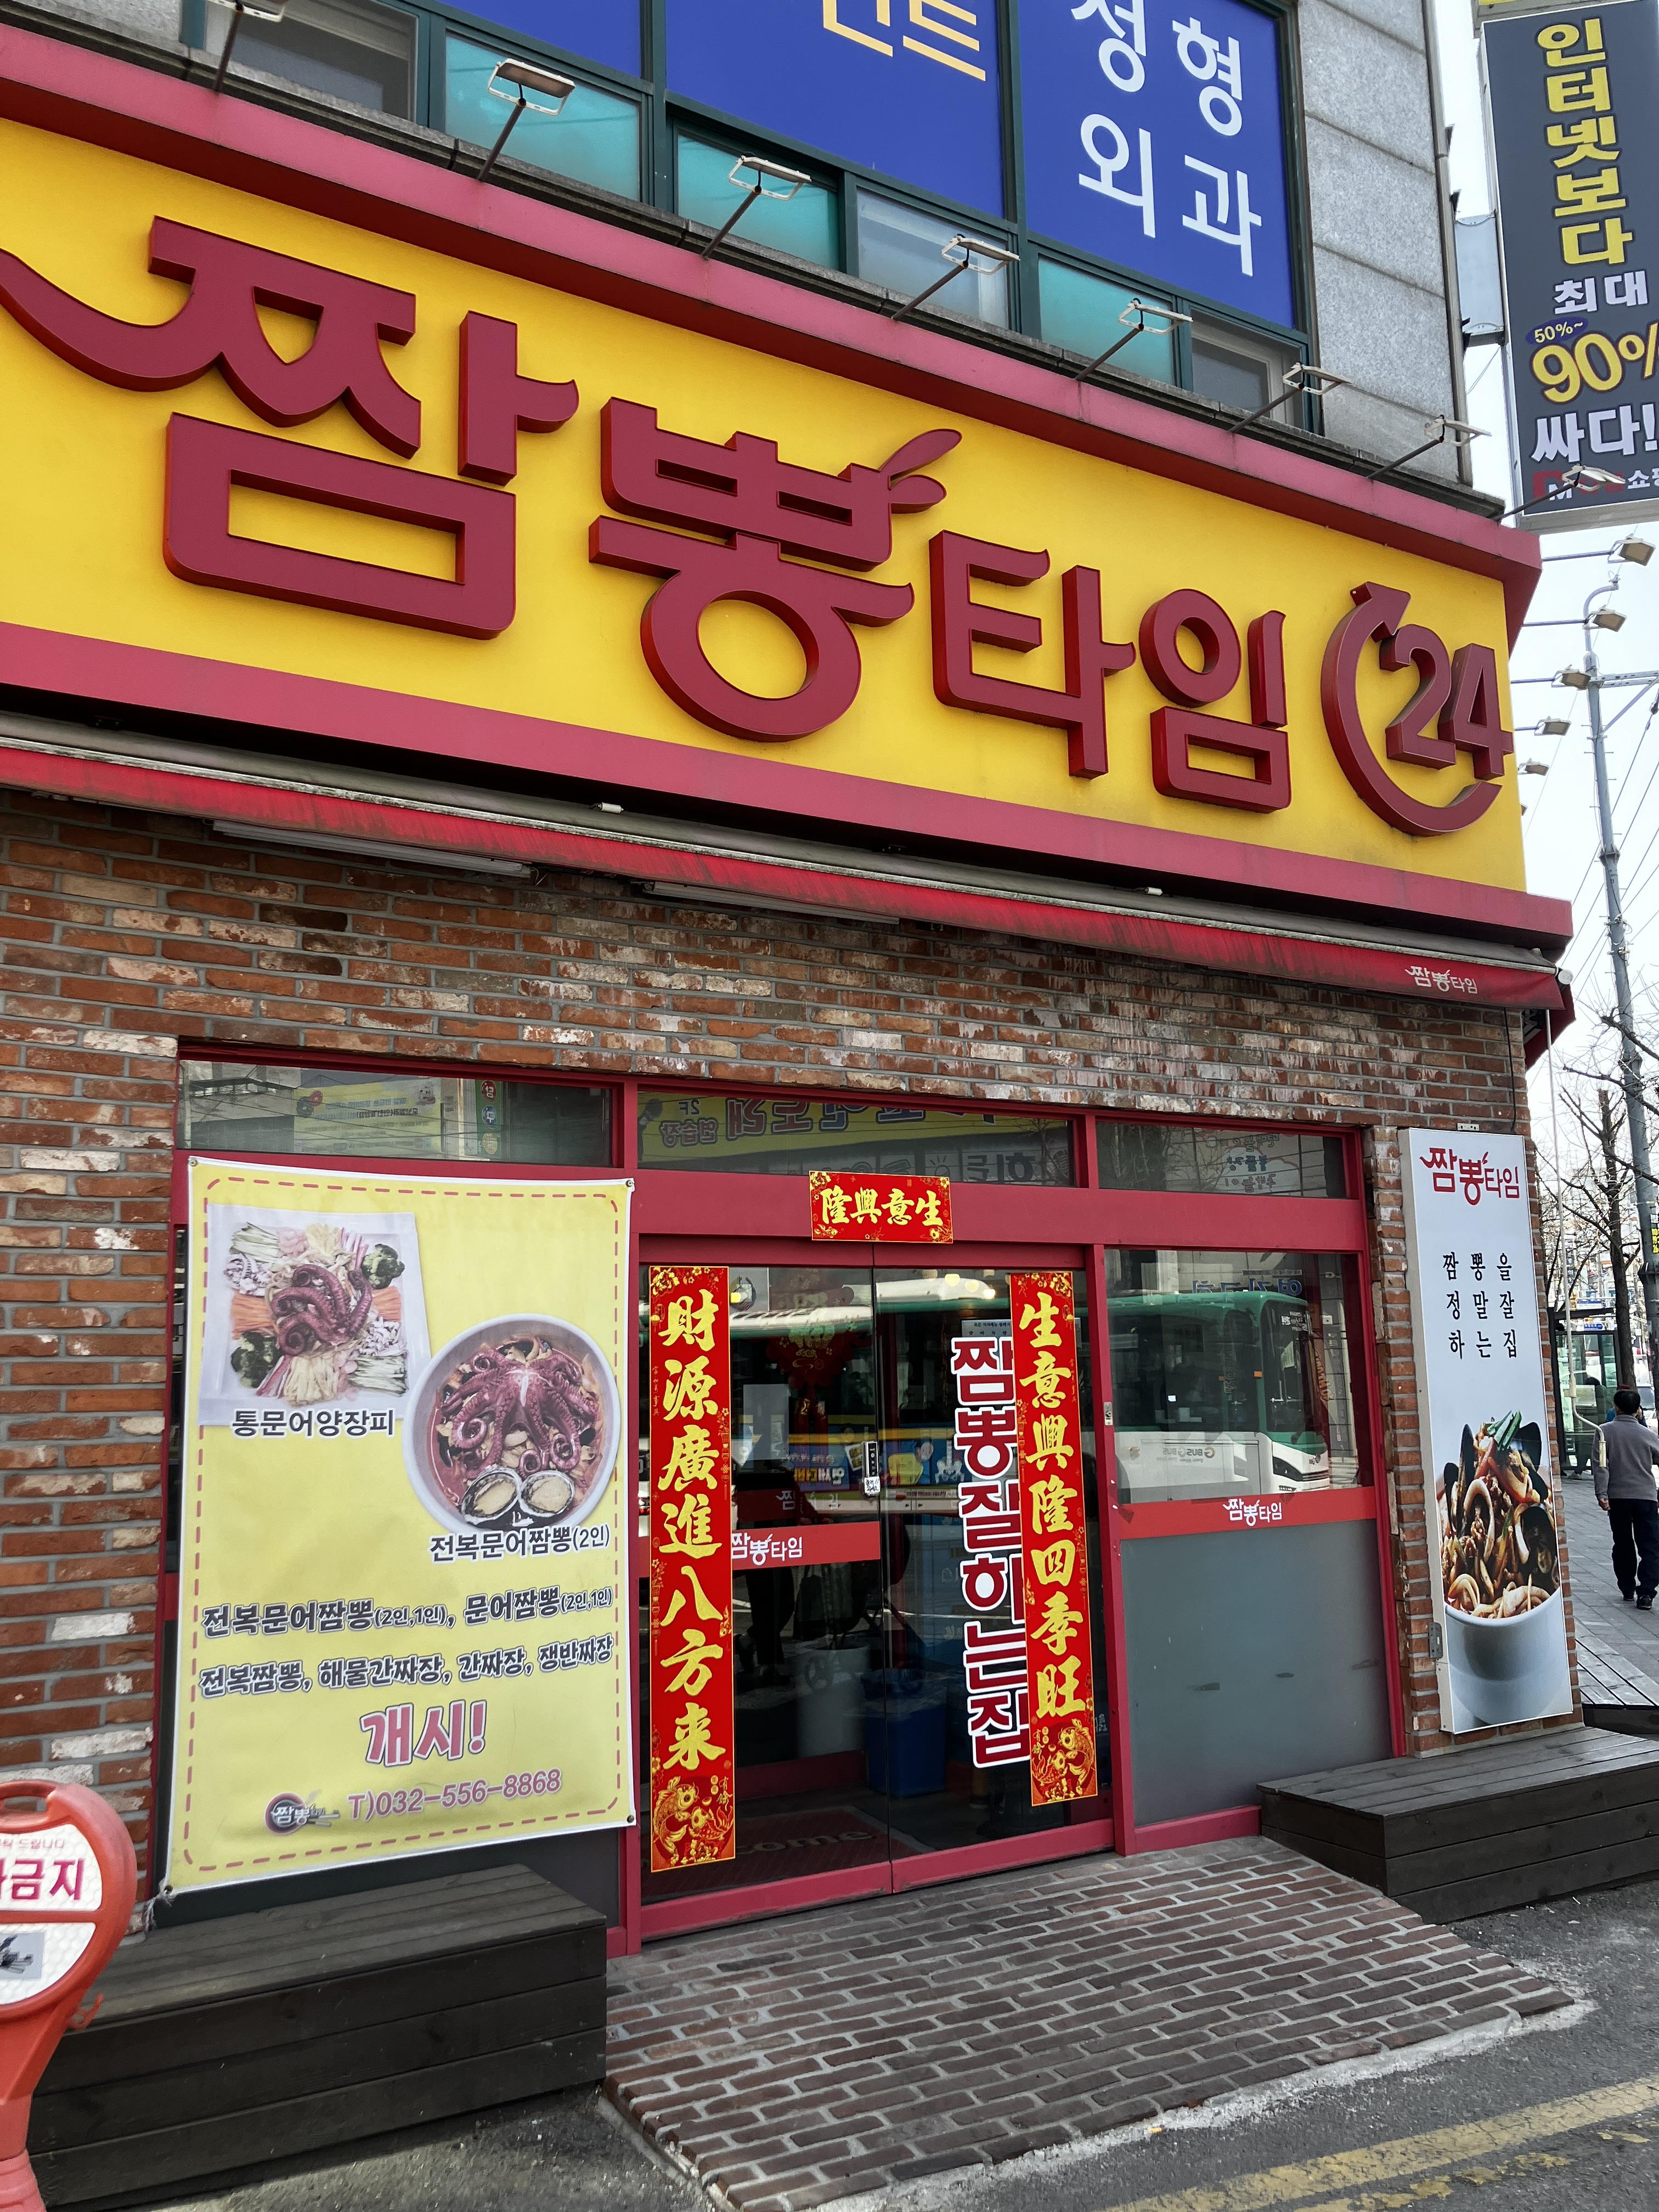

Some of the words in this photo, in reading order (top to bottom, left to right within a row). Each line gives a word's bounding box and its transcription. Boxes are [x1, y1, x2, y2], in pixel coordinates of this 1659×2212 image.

[1071, 0, 1244, 137] 정형
[1537, 18, 1633, 265] 인터넷보다
[1079, 113, 1262, 277] 외과
[1554, 270, 1648, 315] 최대
[1532, 321, 1659, 403] 90%
[1531, 403, 1658, 462] 싸다!
[0, 215, 1293, 814] 짬뽕타임
[1379, 624, 1514, 780] 24
[1404, 965, 1478, 995] 짬뽕타임
[1419, 1147, 1520, 1206] 짬뽕타임
[232, 1409, 394, 1437] 통문어양장피
[1223, 1499, 1283, 1526] 짬뽕타임
[430, 1525, 611, 1563] 전복문어짬뽕(2인)
[731, 1532, 803, 1566] 짬뽕타임
[200, 1659, 313, 1699] 전복짬뽕,
[318, 1654, 453, 1688] 해물간짜장,
[456, 1646, 534, 1682] 간짜장,
[537, 1633, 614, 1672] 쟁반짜장
[359, 1699, 487, 1767] 개시!
